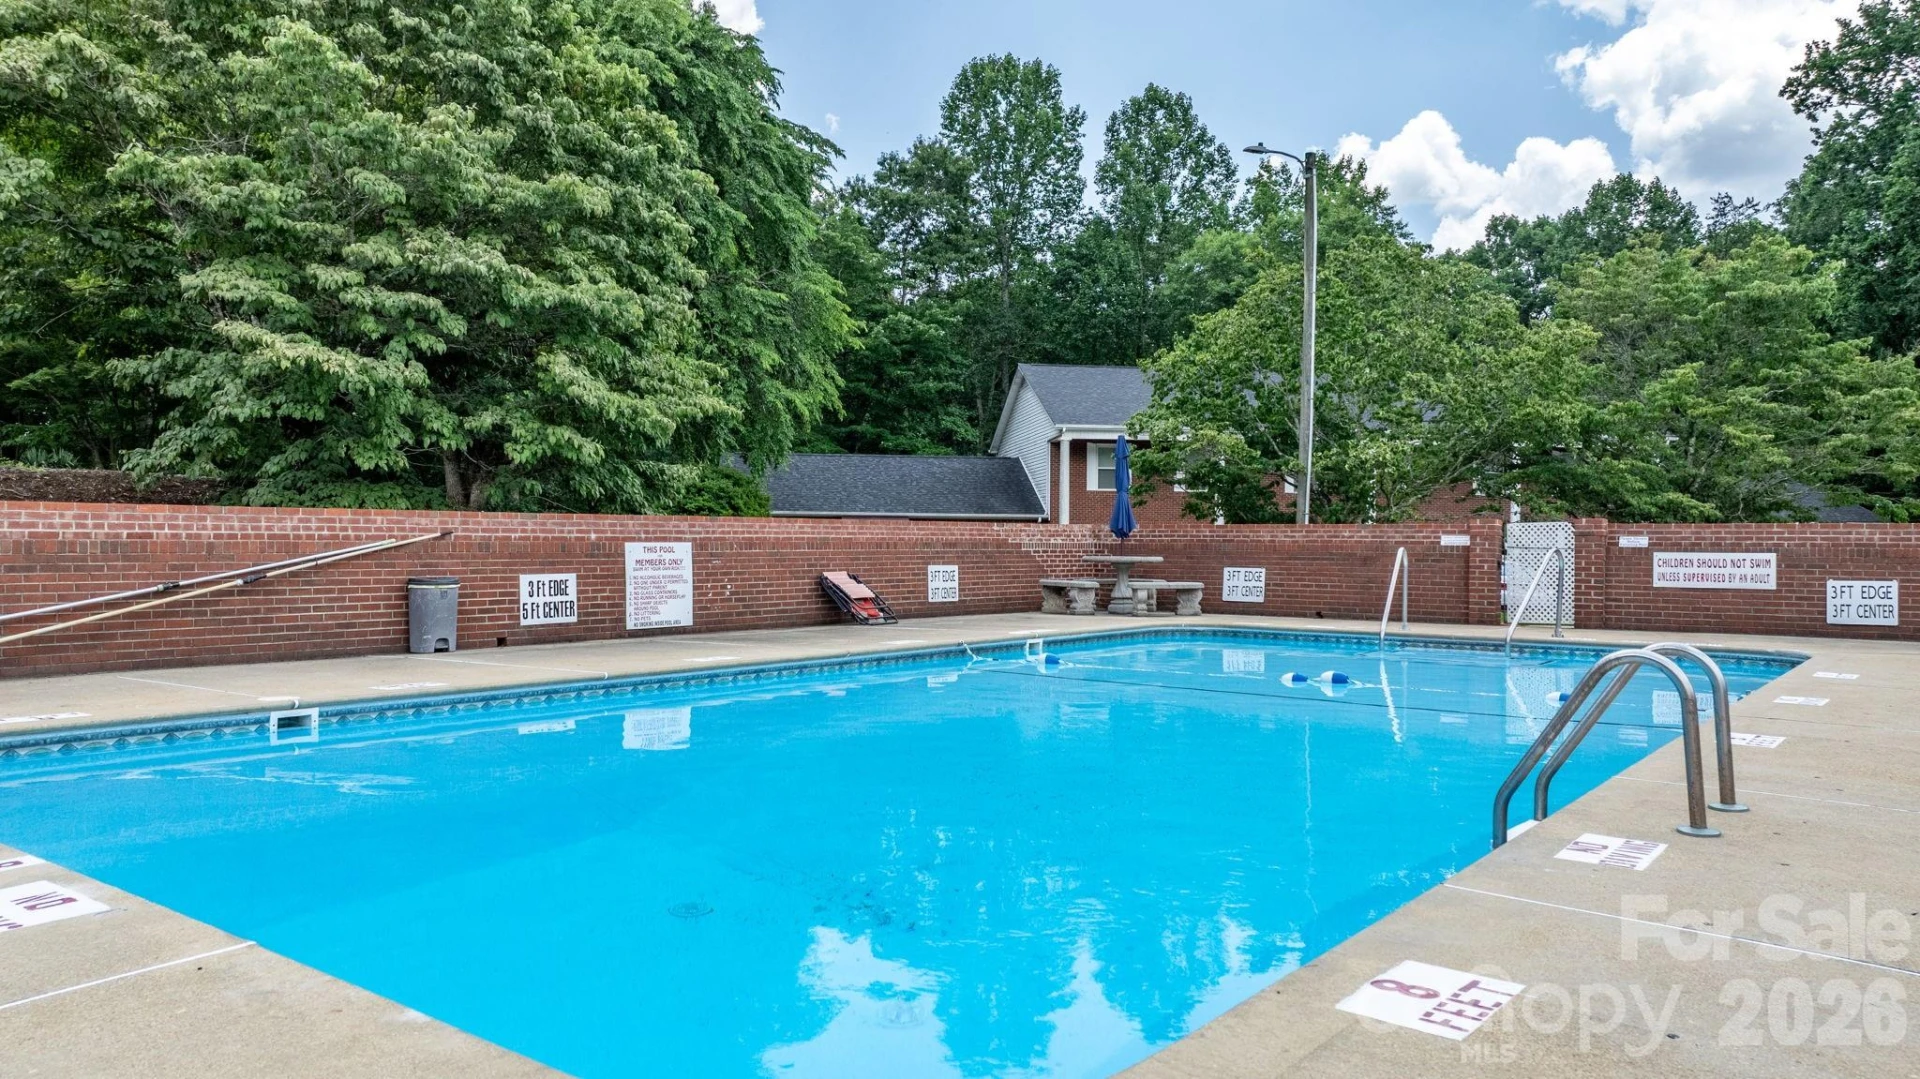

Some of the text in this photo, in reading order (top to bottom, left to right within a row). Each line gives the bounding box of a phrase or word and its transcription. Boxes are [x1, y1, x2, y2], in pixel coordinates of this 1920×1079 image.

[643, 546, 657, 554] THIS
[635, 558, 667, 566] MEMBERS
[1657, 558, 1771, 568] CHILDREN SHOULD NOT SWIM
[942, 570, 956, 582] EDGE
[1244, 571, 1263, 582] EDGE
[1657, 572, 1771, 584] UNLESS SUPERVISED BY AN ADULT
[528, 579, 569, 598] 3 Ft EDGE
[1241, 586, 1264, 597] CENTER
[1861, 585, 1893, 600] EDGE
[522, 600, 575, 620] 5 Ft CENTER
[1856, 604, 1895, 619] CENTER
[9, 891, 78, 911] NO
[1370, 979, 1440, 999] 8
[1418, 980, 1514, 1032] FEET
